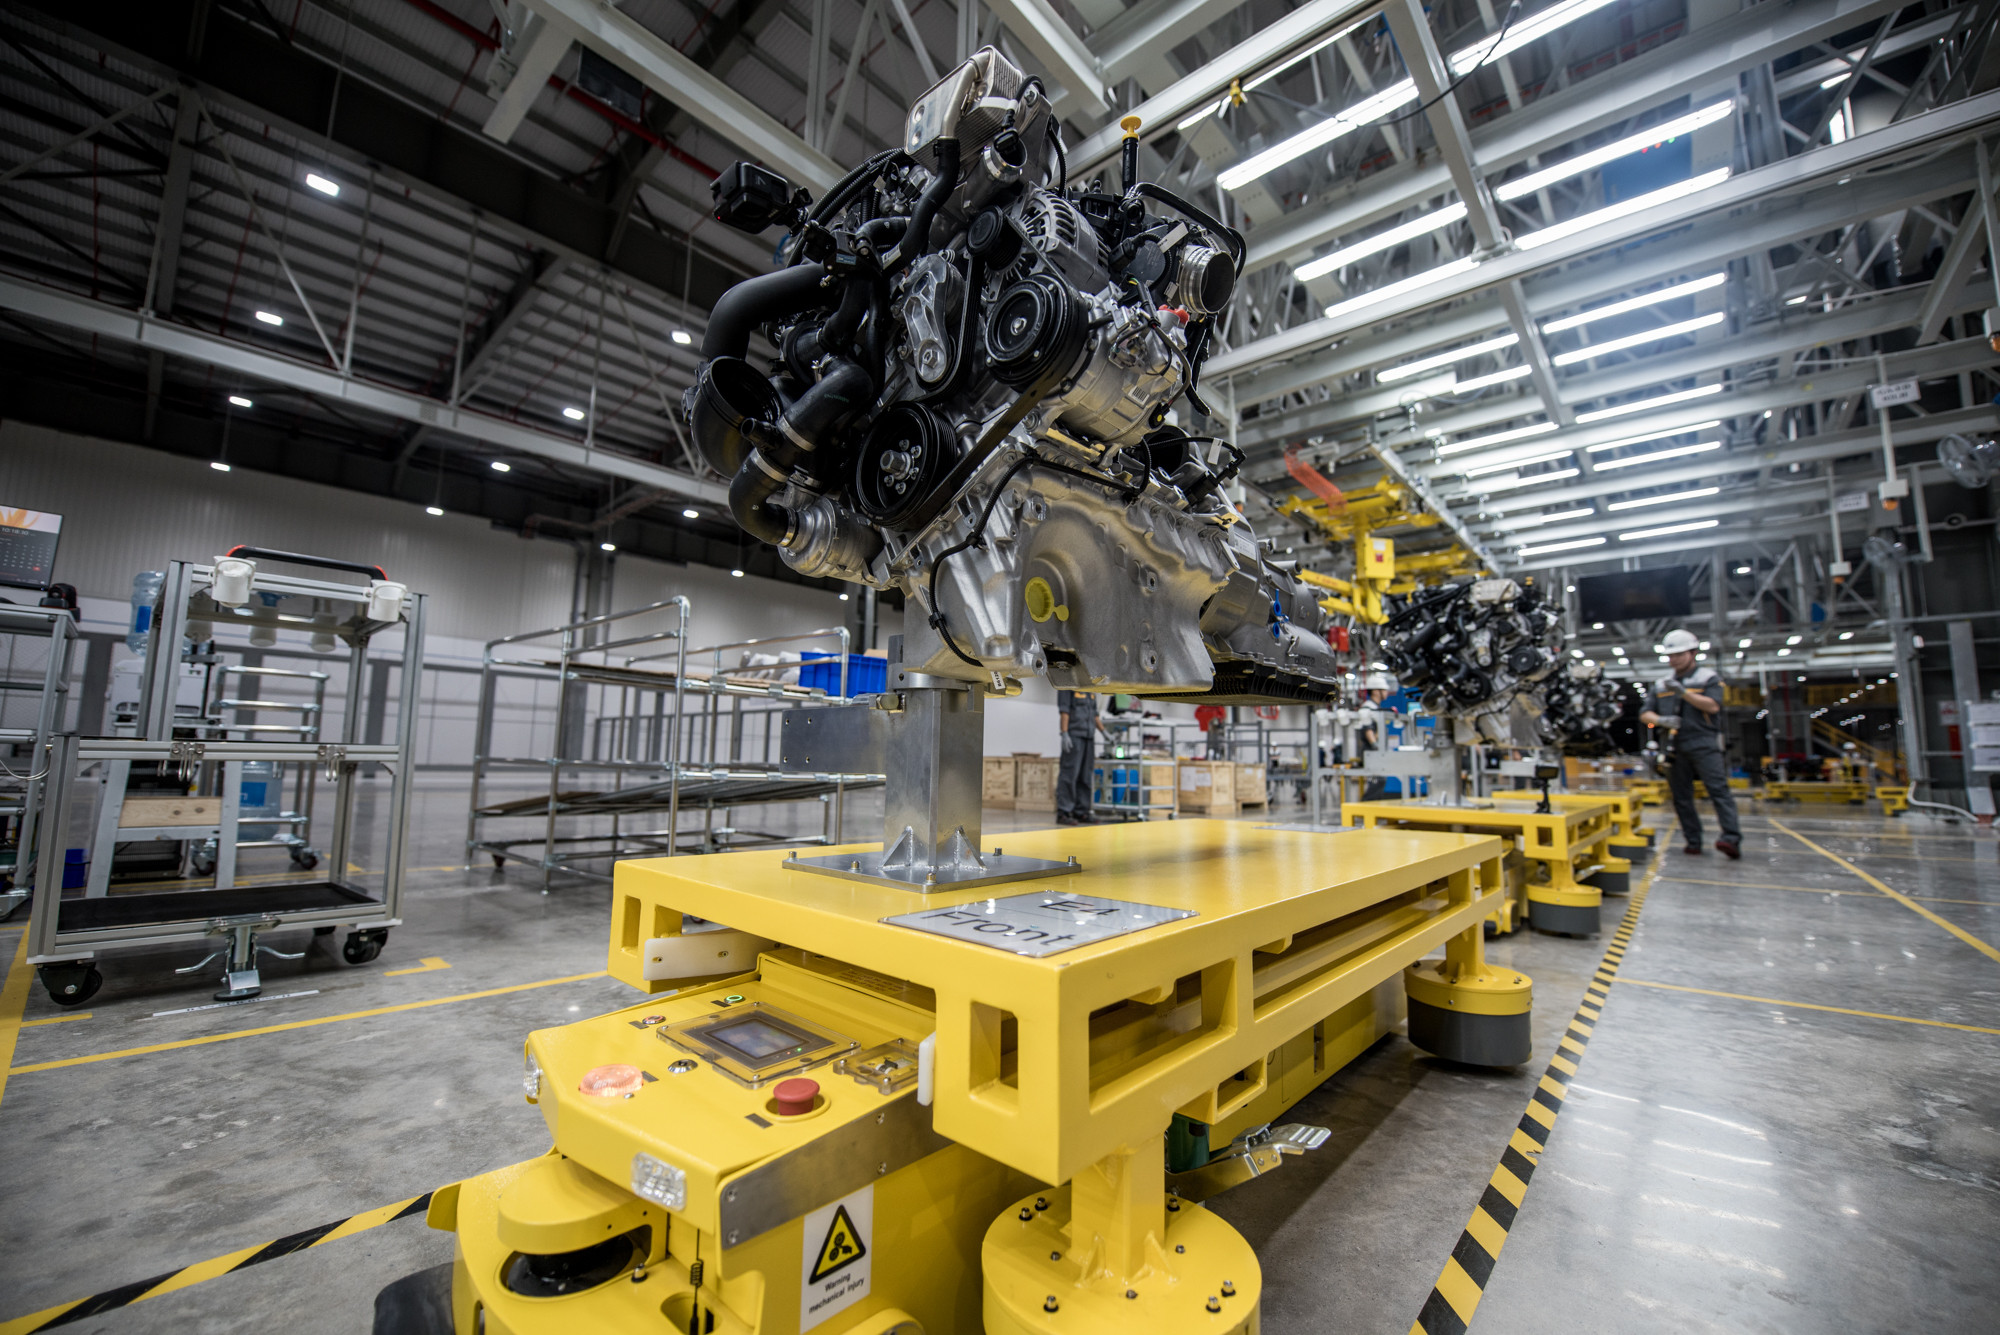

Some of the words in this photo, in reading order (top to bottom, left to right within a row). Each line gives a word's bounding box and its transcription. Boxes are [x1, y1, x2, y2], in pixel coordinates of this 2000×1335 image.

[1039, 900, 1121, 916] E4
[920, 911, 1076, 945] Front
[809, 1287, 844, 1313] mechanical
[847, 1278, 864, 1291] injury
[825, 1273, 851, 1292] Warning
